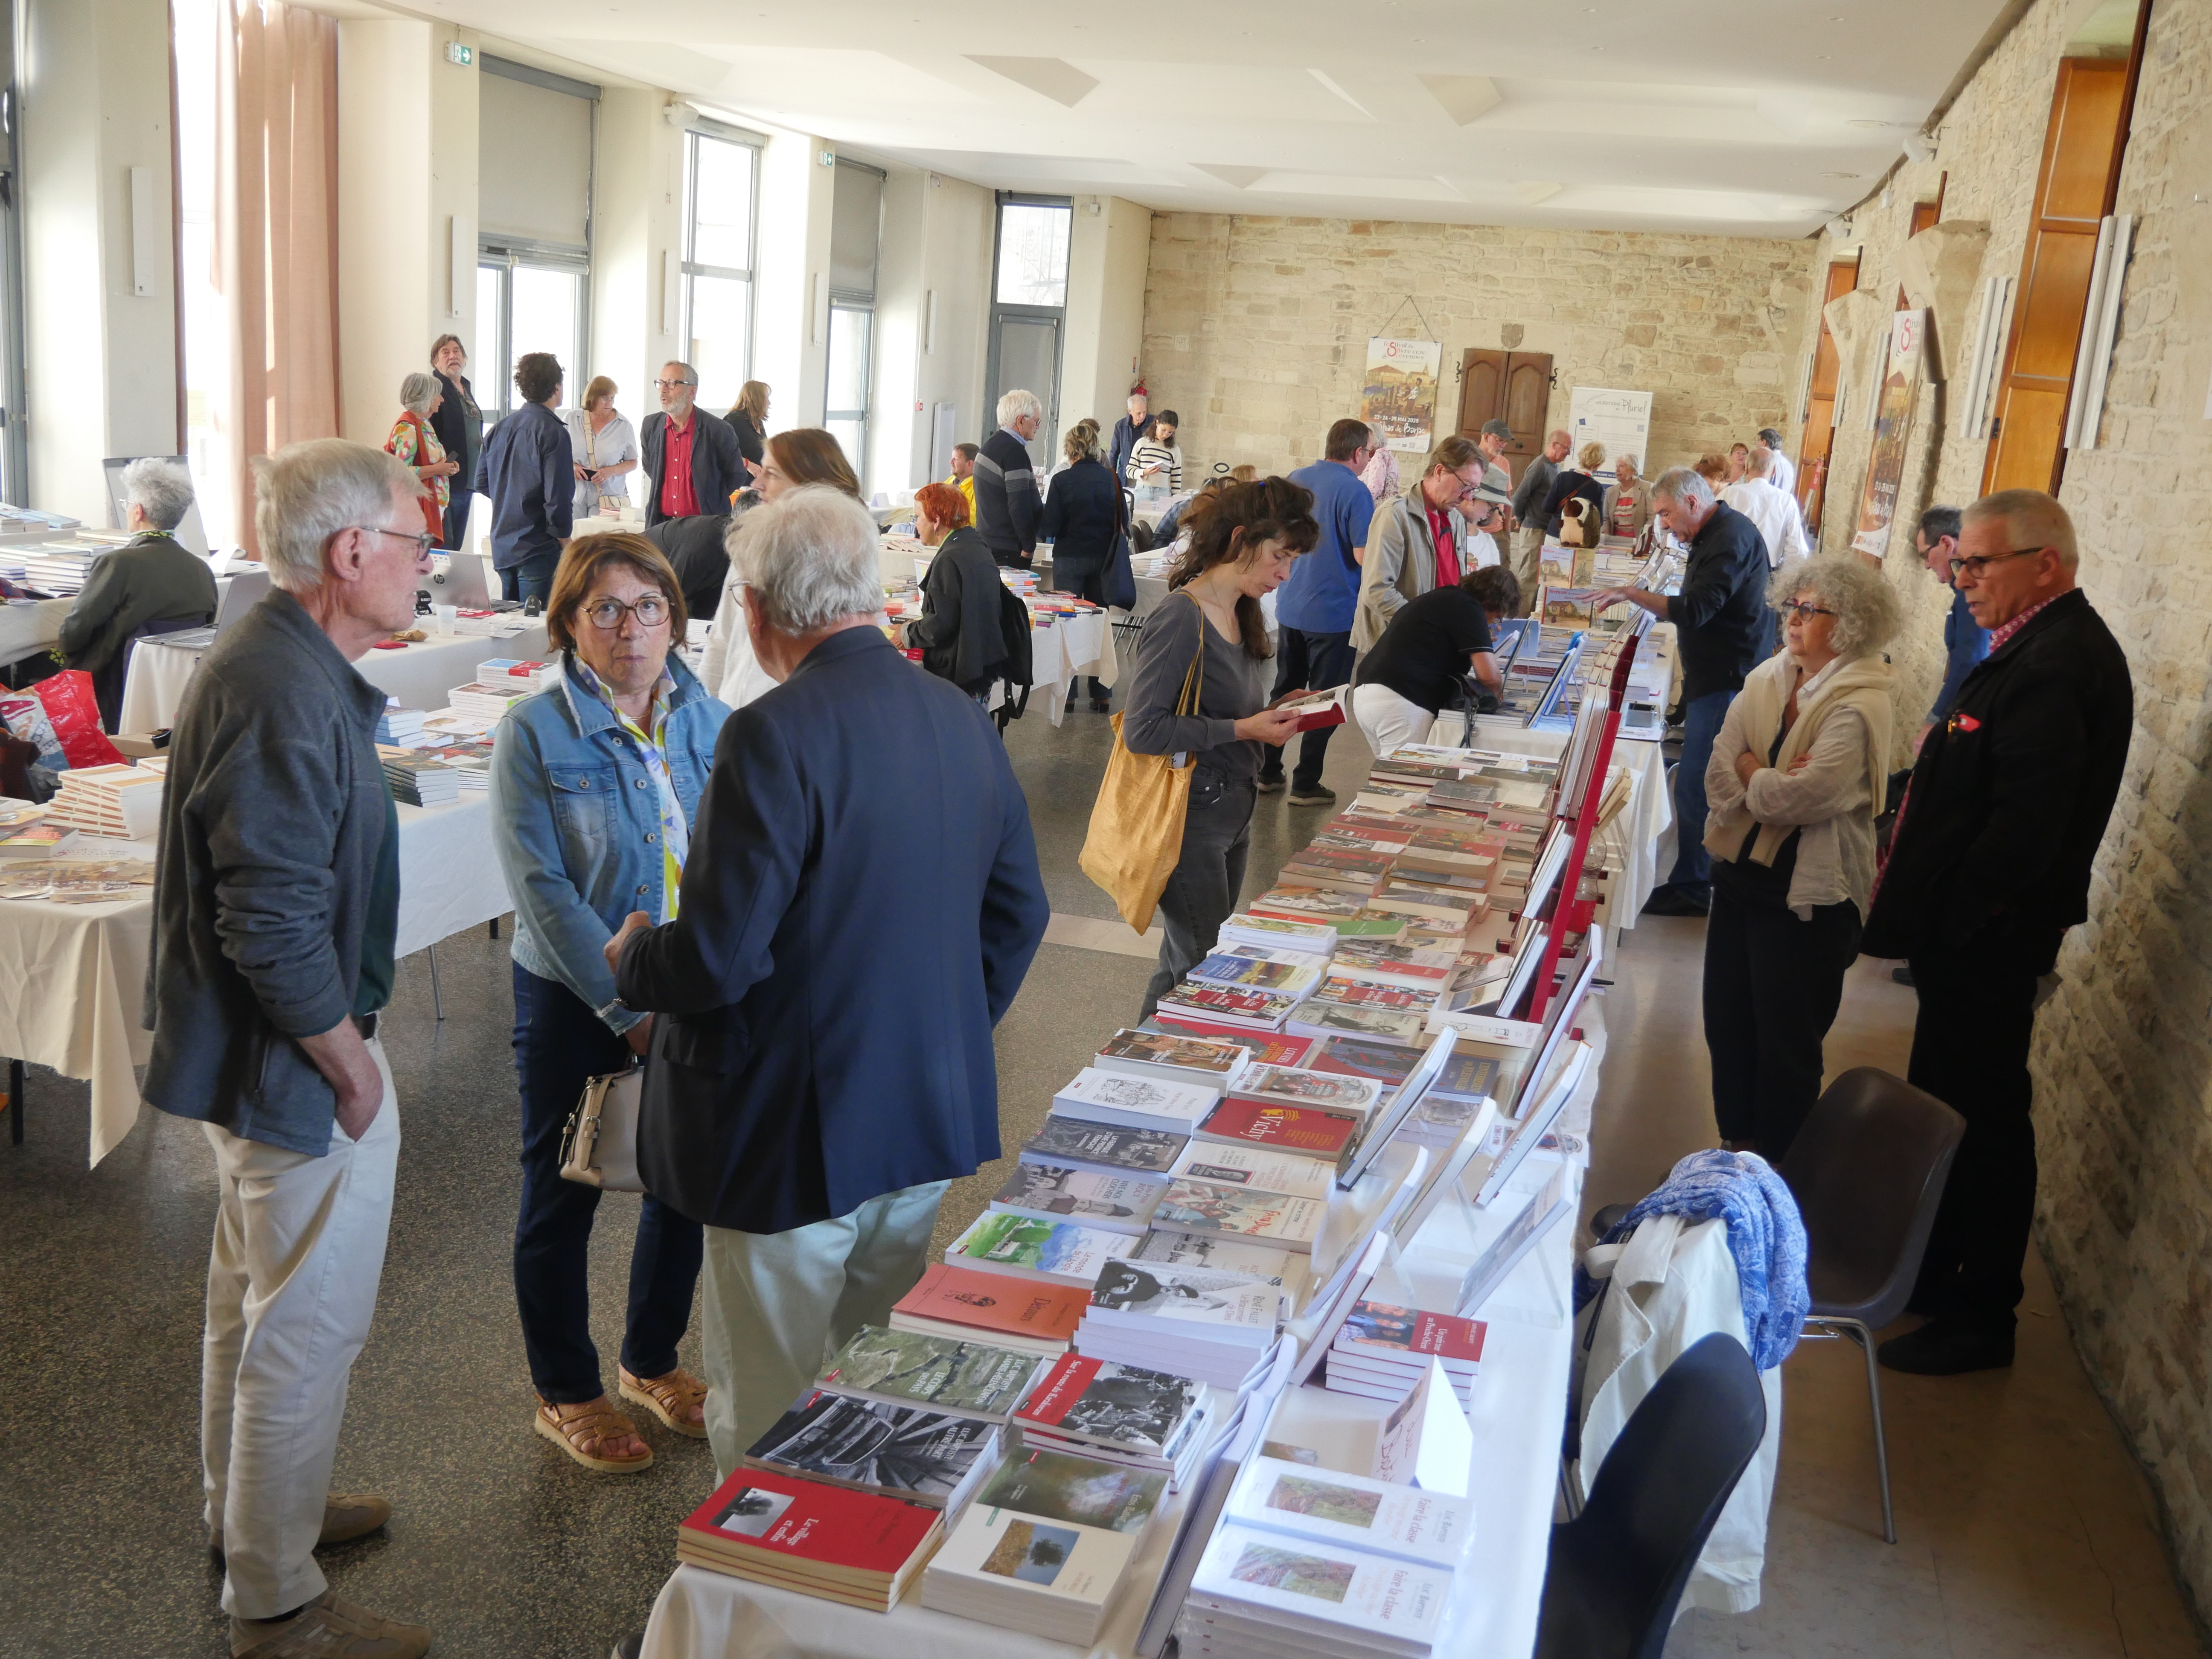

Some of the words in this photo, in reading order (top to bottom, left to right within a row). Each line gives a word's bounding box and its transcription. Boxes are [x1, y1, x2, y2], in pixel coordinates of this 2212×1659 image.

[1621, 399, 1647, 415] Pluriel
[1404, 422, 1426, 437] Barjac
[435, 575, 444, 585] hp
[1275, 1046, 1298, 1064] LOUISES
[1239, 1112, 1284, 1141] Vichy
[1101, 1178, 1121, 1199] CLOCHERS
[1117, 1180, 1129, 1190] VIVE
[1131, 1182, 1147, 1197] RIOUX
[1112, 1190, 1124, 1199] NOS
[1292, 1213, 1302, 1222] crime
[1057, 1255, 1080, 1271] l'Angle
[1069, 1257, 1093, 1274] monde
[1252, 1295, 1265, 1307] RENÉ
[1017, 1296, 1052, 1324] Détours
[1224, 1310, 1234, 1321] Dieu
[1234, 1299, 1248, 1322] Braconnier
[1248, 1307, 1262, 1324] FALLET
[1417, 1322, 1437, 1349] Proche-Orient
[1432, 1334, 1447, 1344] petit
[1437, 1327, 1448, 1336] Un
[1433, 1343, 1441, 1351] tour
[1010, 1359, 1025, 1370] LUC
[1068, 1359, 1083, 1369] Sur
[917, 1372, 930, 1380] DES
[996, 1369, 1019, 1391] BAPTISTE
[1055, 1374, 1071, 1386] route
[907, 1379, 926, 1393] PAYS
[919, 1377, 942, 1395] CORPS
[973, 1388, 993, 1405] LAFON
[1031, 1392, 1058, 1416] Karakoram
[938, 1425, 960, 1444] AUTRE
[956, 1427, 972, 1439] LUC
[928, 1444, 947, 1458] PART
[942, 1438, 965, 1461] BAPTISTE
[1126, 1493, 1143, 1506] Enis
[1413, 1497, 1431, 1515] Faire
[802, 1517, 820, 1527] Le
[1412, 1514, 1426, 1522] la
[1441, 1509, 1455, 1521] LUC
[781, 1519, 796, 1528] et
[768, 1526, 793, 1543] enfin
[781, 1525, 813, 1547] village
[1405, 1522, 1423, 1544] classe
[1436, 1520, 1452, 1543] BAPTISTE
[1390, 1569, 1409, 1588] Faire
[1387, 1587, 1403, 1596] la
[1419, 1582, 1434, 1595] LUC
[1379, 1595, 1400, 1620] classe
[1412, 1594, 1430, 1619] BAPTISTE
